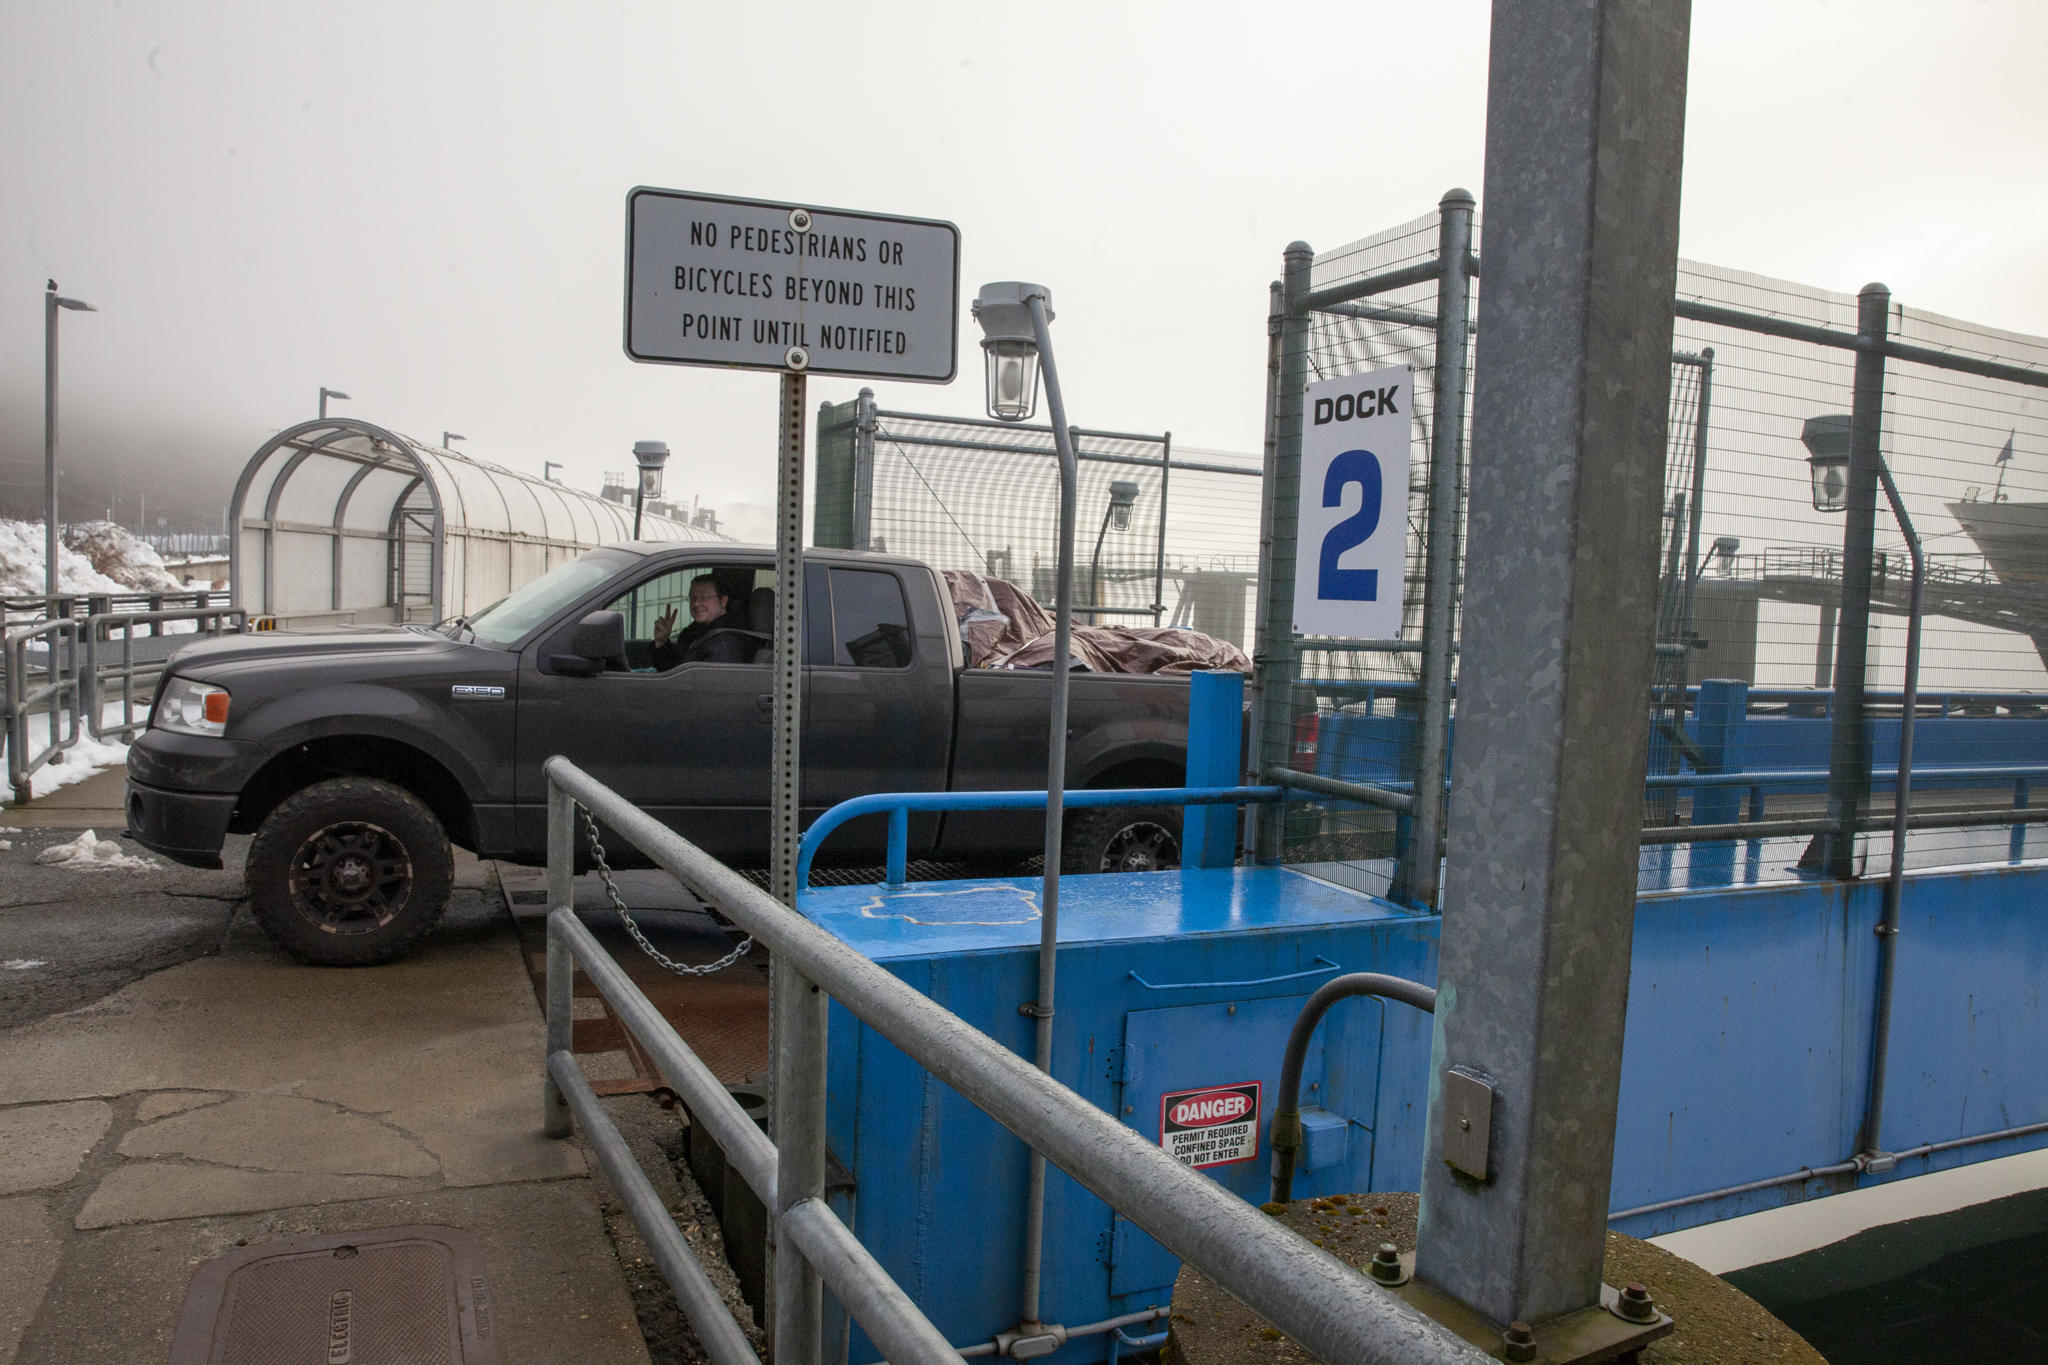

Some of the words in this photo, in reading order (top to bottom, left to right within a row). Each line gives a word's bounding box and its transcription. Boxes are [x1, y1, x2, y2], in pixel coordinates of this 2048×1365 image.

[690, 221, 718, 248] NO
[731, 225, 867, 263] PEDESTRIANS
[879, 240, 904, 266] OR
[674, 266, 773, 299] BICYCLES
[786, 277, 864, 307] BEYOND
[874, 285, 916, 312] THIS
[682, 314, 743, 342] POINT
[753, 320, 810, 348] UNTIL
[820, 325, 907, 356] NOTIFIED
[1314, 385, 1400, 426] DOCK
[1317, 449, 1383, 602] 2
[1176, 1096, 1246, 1123] DANGER
[1172, 1131, 1206, 1145] PERMIT
[1207, 1124, 1249, 1139] REQUIRED
[1174, 1142, 1217, 1155] CONFINED
[1218, 1136, 1245, 1149] SPACE
[1194, 1153, 1211, 1164] NOT
[1212, 1148, 1239, 1161] ENTER
[330, 1296, 349, 1358] ELECTRIC
